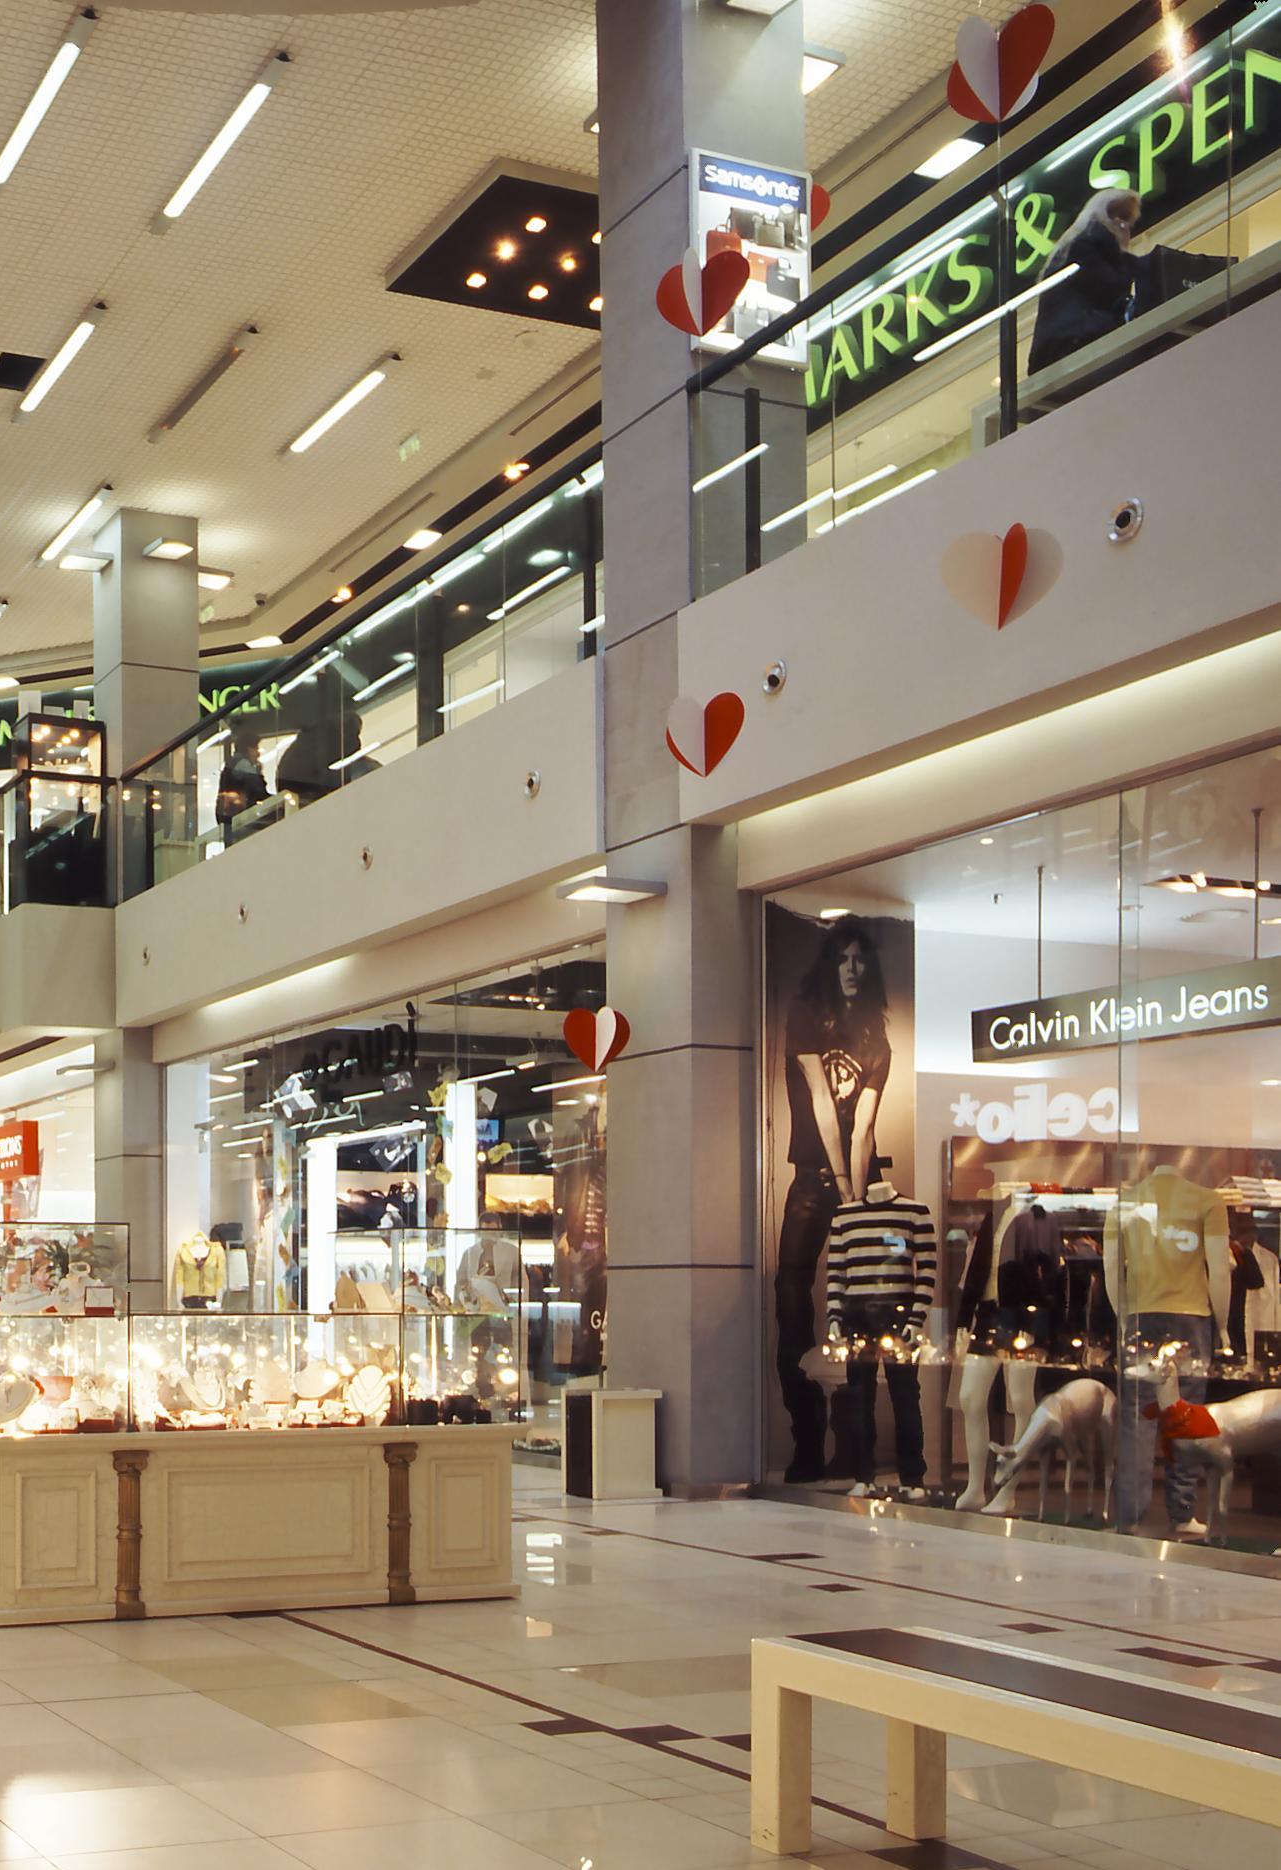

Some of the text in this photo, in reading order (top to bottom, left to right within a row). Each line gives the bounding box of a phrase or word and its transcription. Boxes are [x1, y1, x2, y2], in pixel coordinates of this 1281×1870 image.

[704, 164, 801, 202] Samsonite
[1015, 193, 1060, 273] &
[989, 984, 1269, 1050] Calvin Klein Jeans
